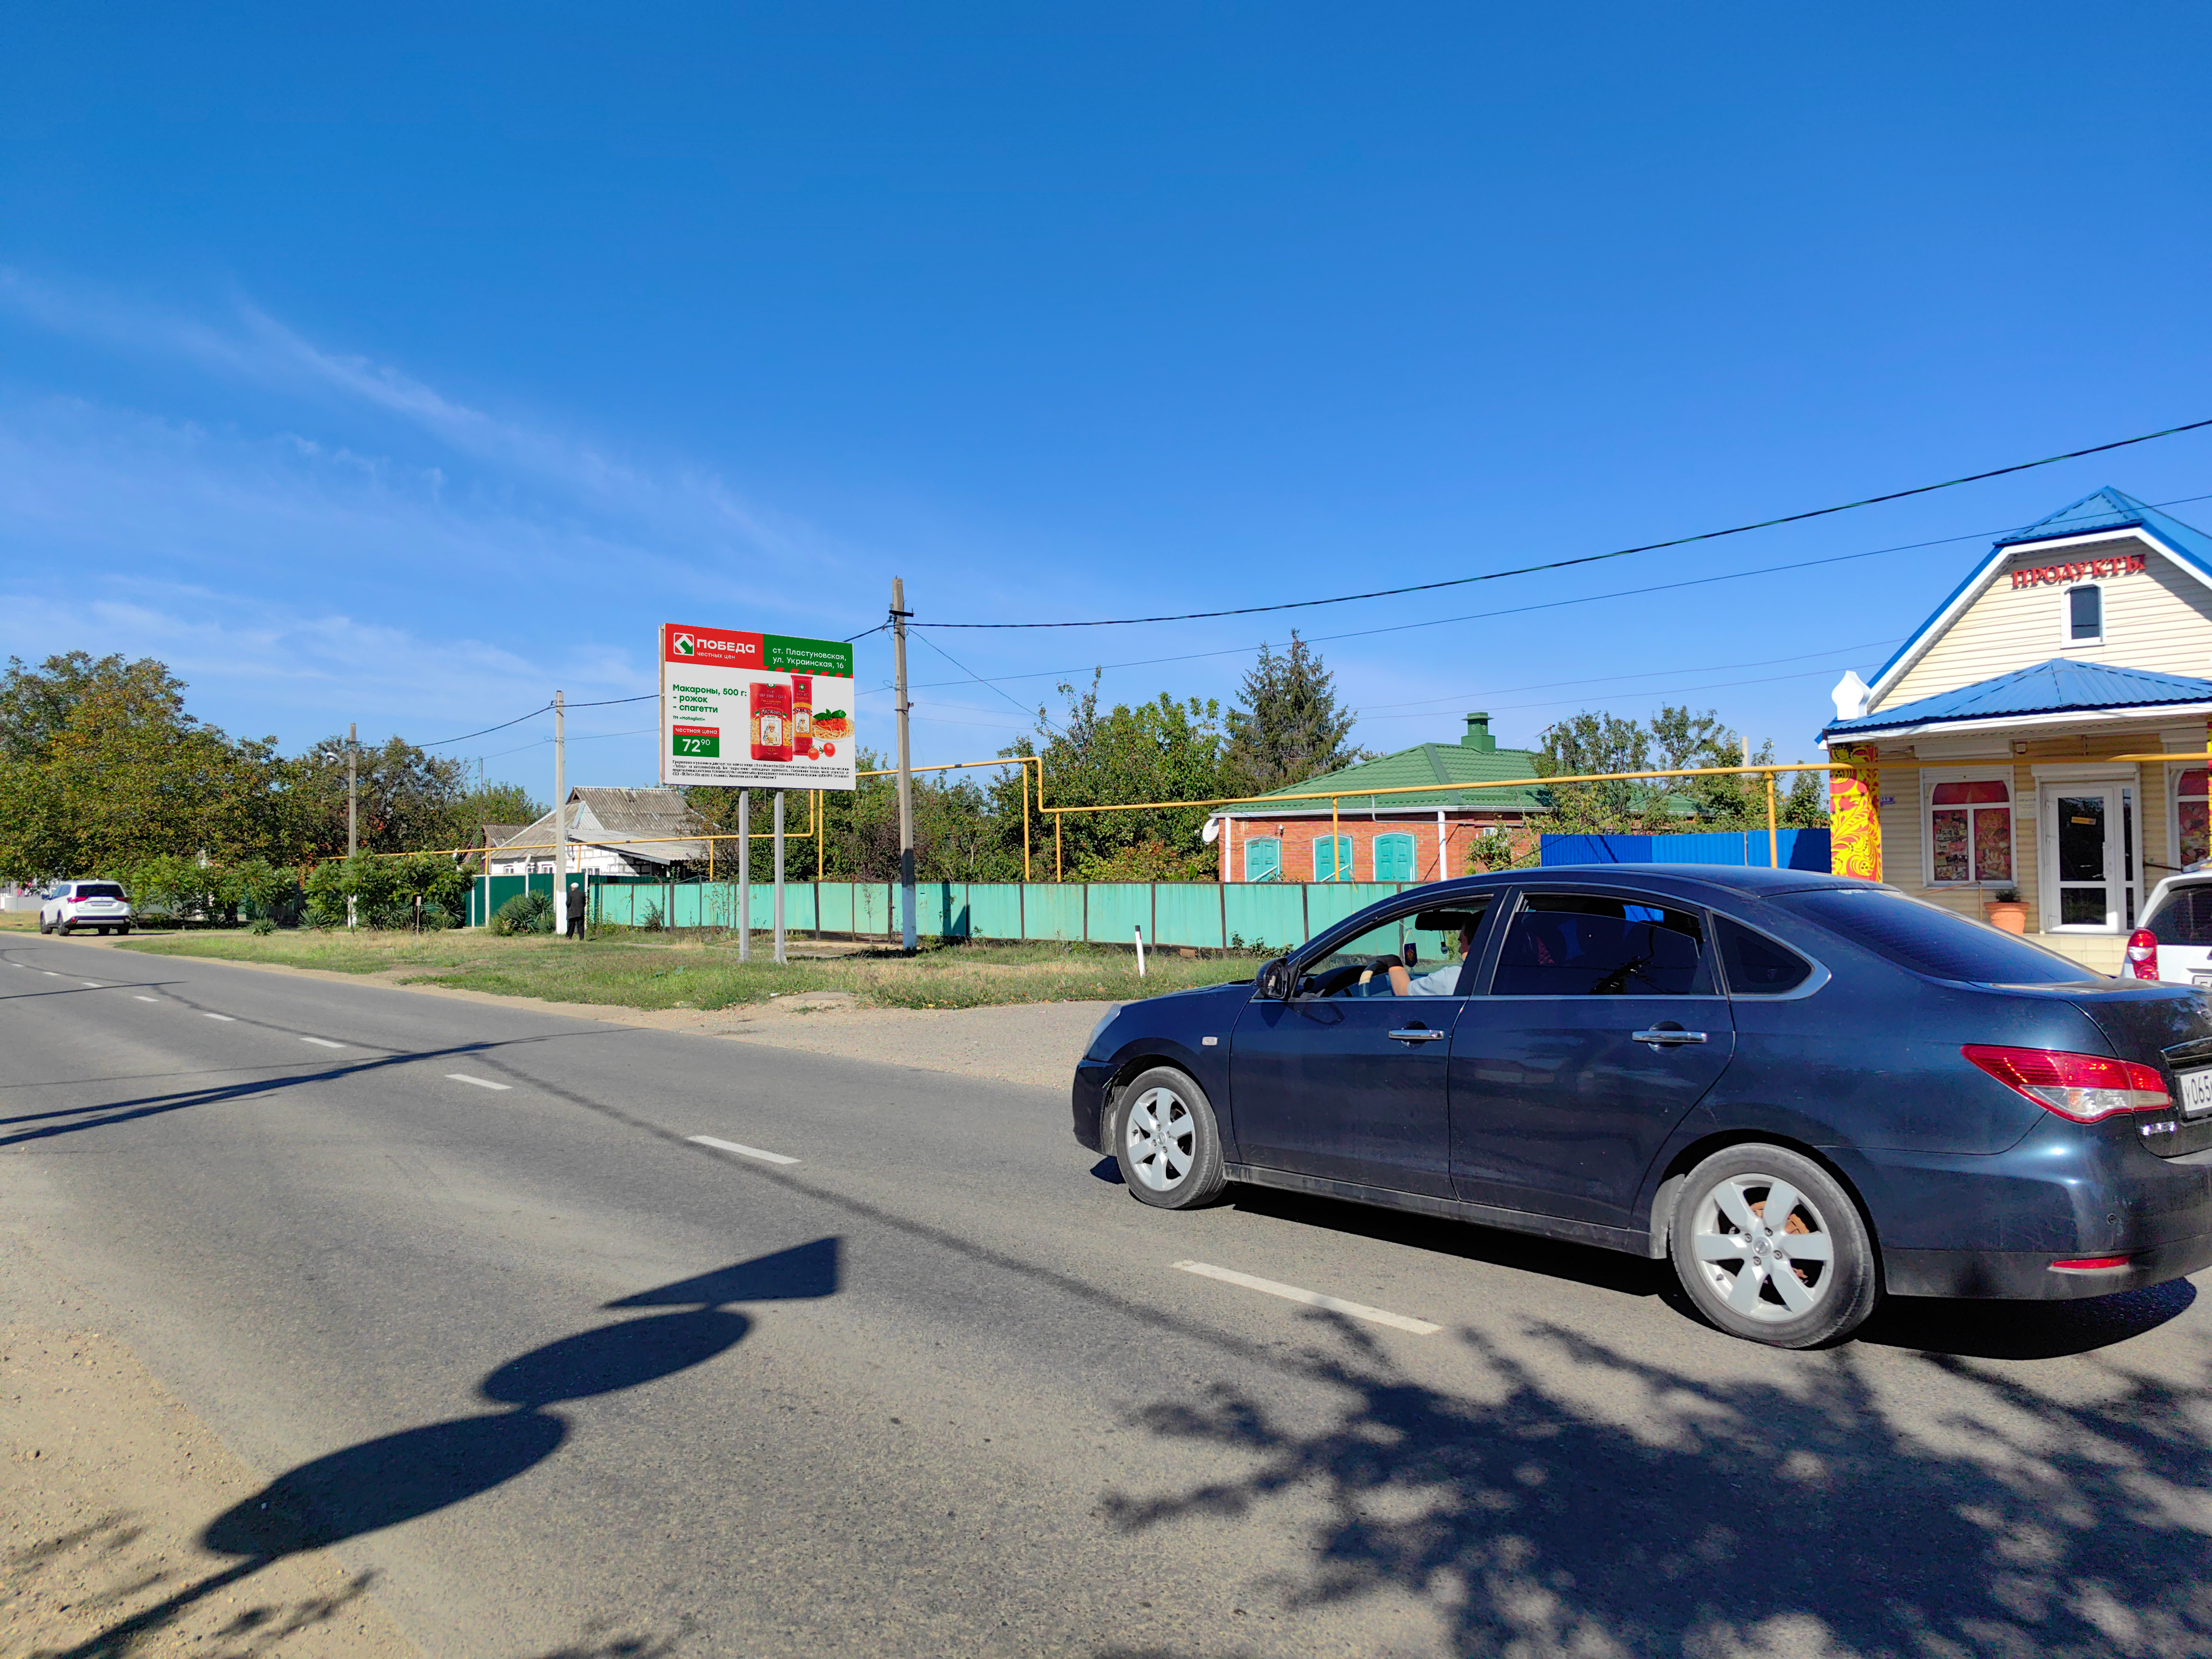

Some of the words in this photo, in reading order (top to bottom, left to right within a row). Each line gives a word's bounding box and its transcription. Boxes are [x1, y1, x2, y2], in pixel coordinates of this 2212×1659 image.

[2012, 554, 2146, 586] ПРОДУКТЫ
[786, 648, 847, 662] Пластуновская,
[786, 657, 834, 669] Украинская,
[672, 684, 720, 696] Макароны,
[723, 688, 739, 696] 500
[679, 695, 708, 703] рожок
[679, 704, 718, 713] спагетти
